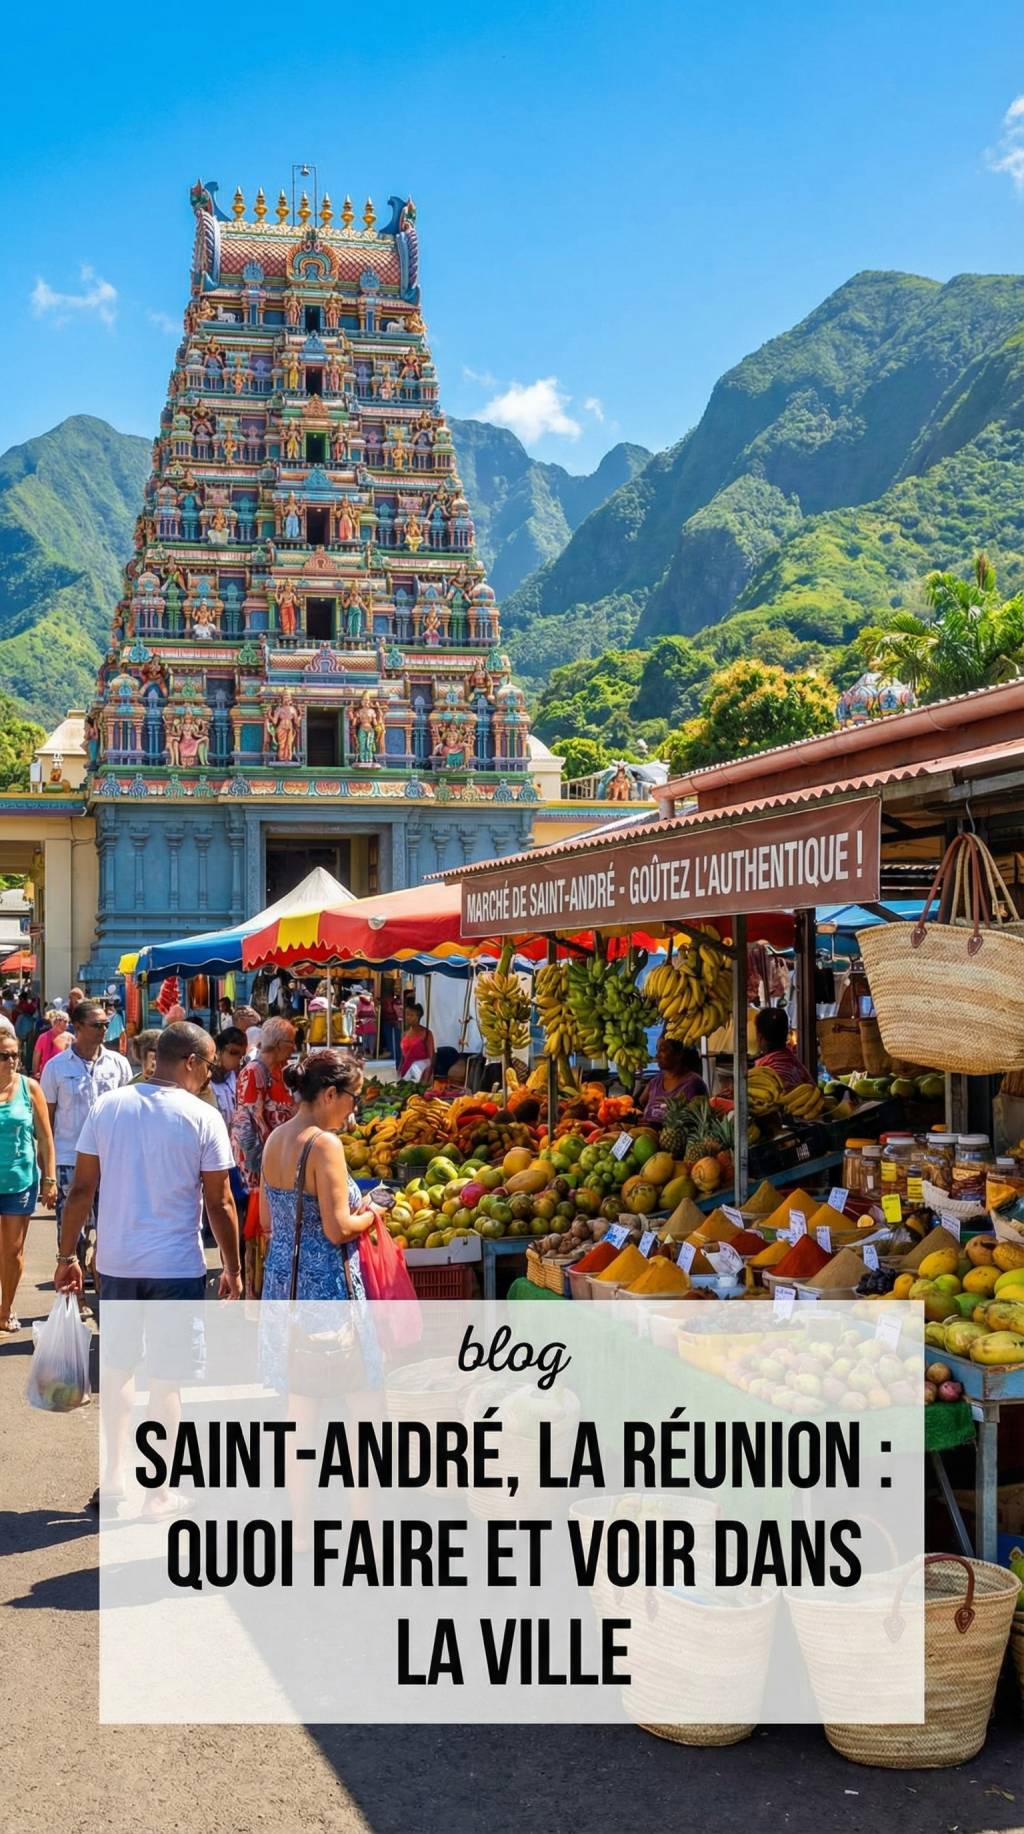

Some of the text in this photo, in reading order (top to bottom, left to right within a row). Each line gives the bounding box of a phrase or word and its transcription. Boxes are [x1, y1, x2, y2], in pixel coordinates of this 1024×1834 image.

[467, 879, 509, 923] MARCHÉ
[512, 885, 527, 920] DE
[529, 862, 616, 917] SAINT-ANDRÉ
[629, 855, 690, 905] GOÛTEZ
[695, 832, 849, 897] L'AUTHENTIQUE
